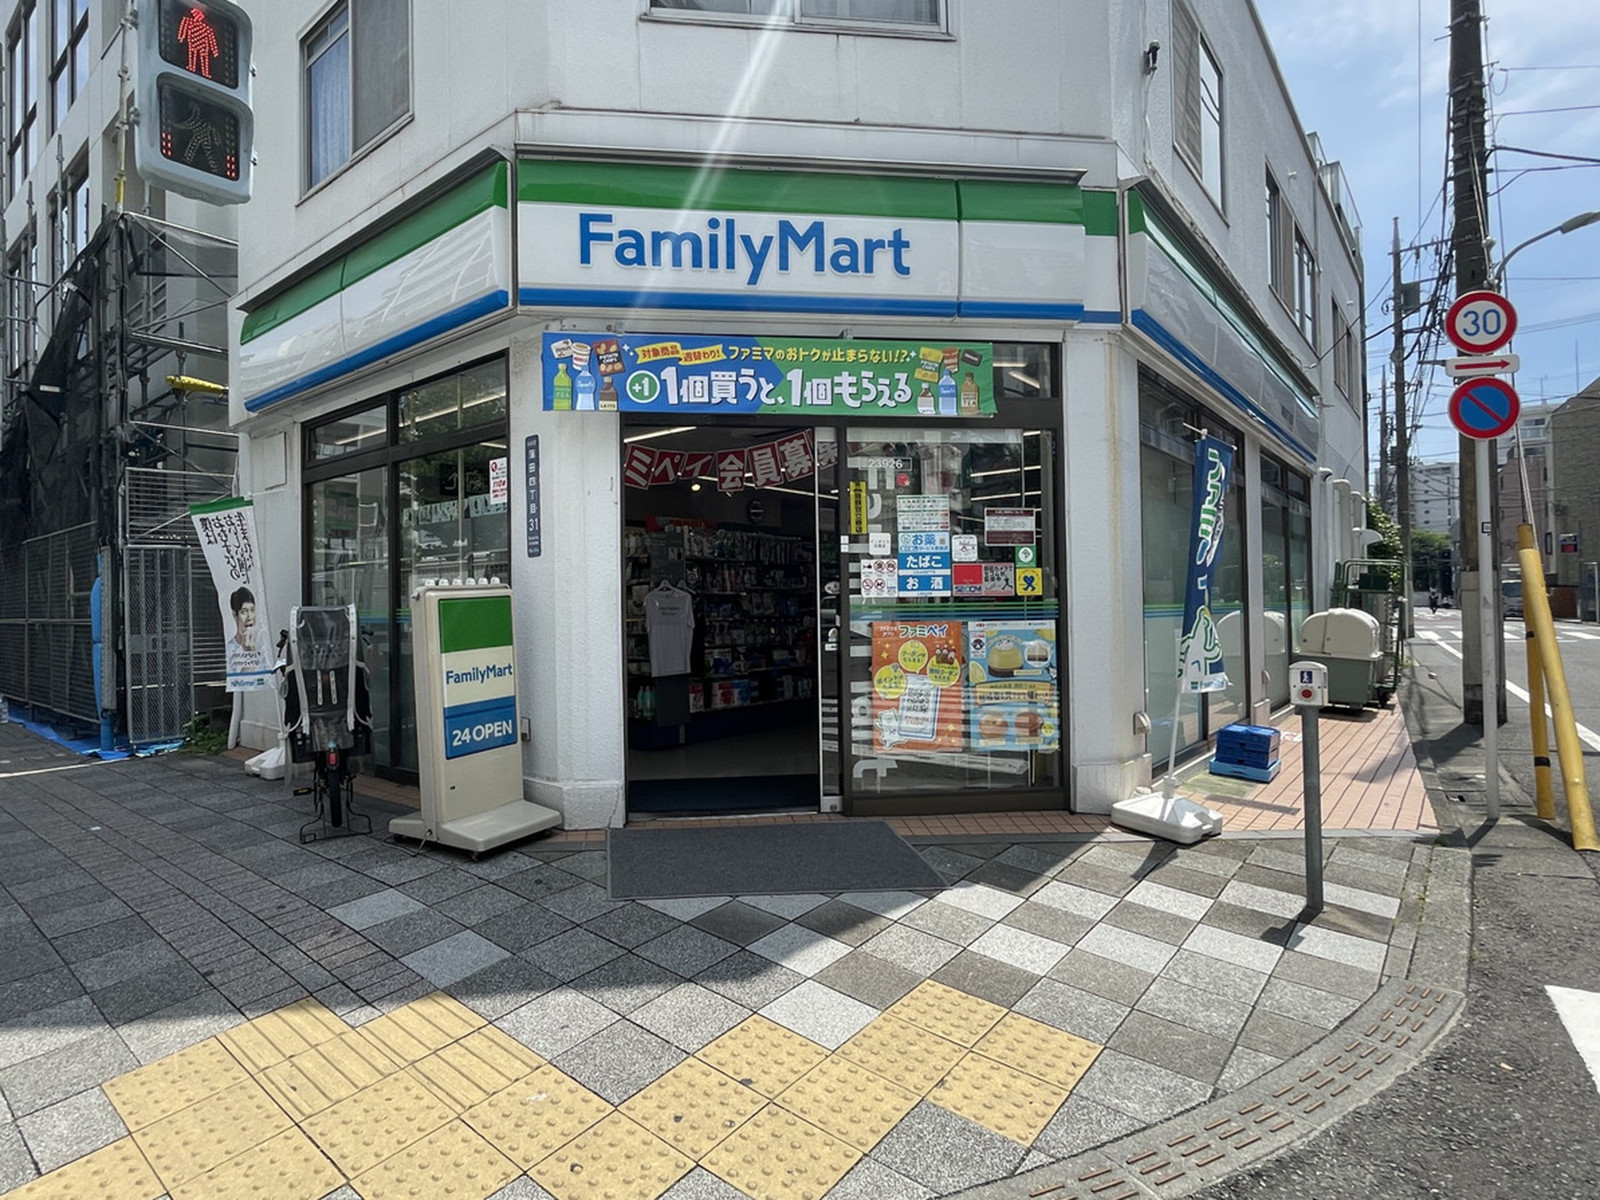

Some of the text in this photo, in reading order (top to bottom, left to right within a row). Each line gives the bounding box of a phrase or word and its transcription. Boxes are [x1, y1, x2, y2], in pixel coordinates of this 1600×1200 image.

[579, 212, 911, 286] FamilyMart
[1462, 309, 1502, 337] 30
[641, 344, 680, 359] 対象商品
[660, 366, 912, 408] 1個買うと、1個もらえる
[868, 459, 903, 469] 23926
[912, 533, 937, 546] お薬
[906, 555, 943, 568] たばこ
[906, 576, 944, 589] お酒
[899, 624, 949, 638] ファミペイ
[445, 663, 513, 685] FamilyMart
[474, 719, 513, 742] OPEN
